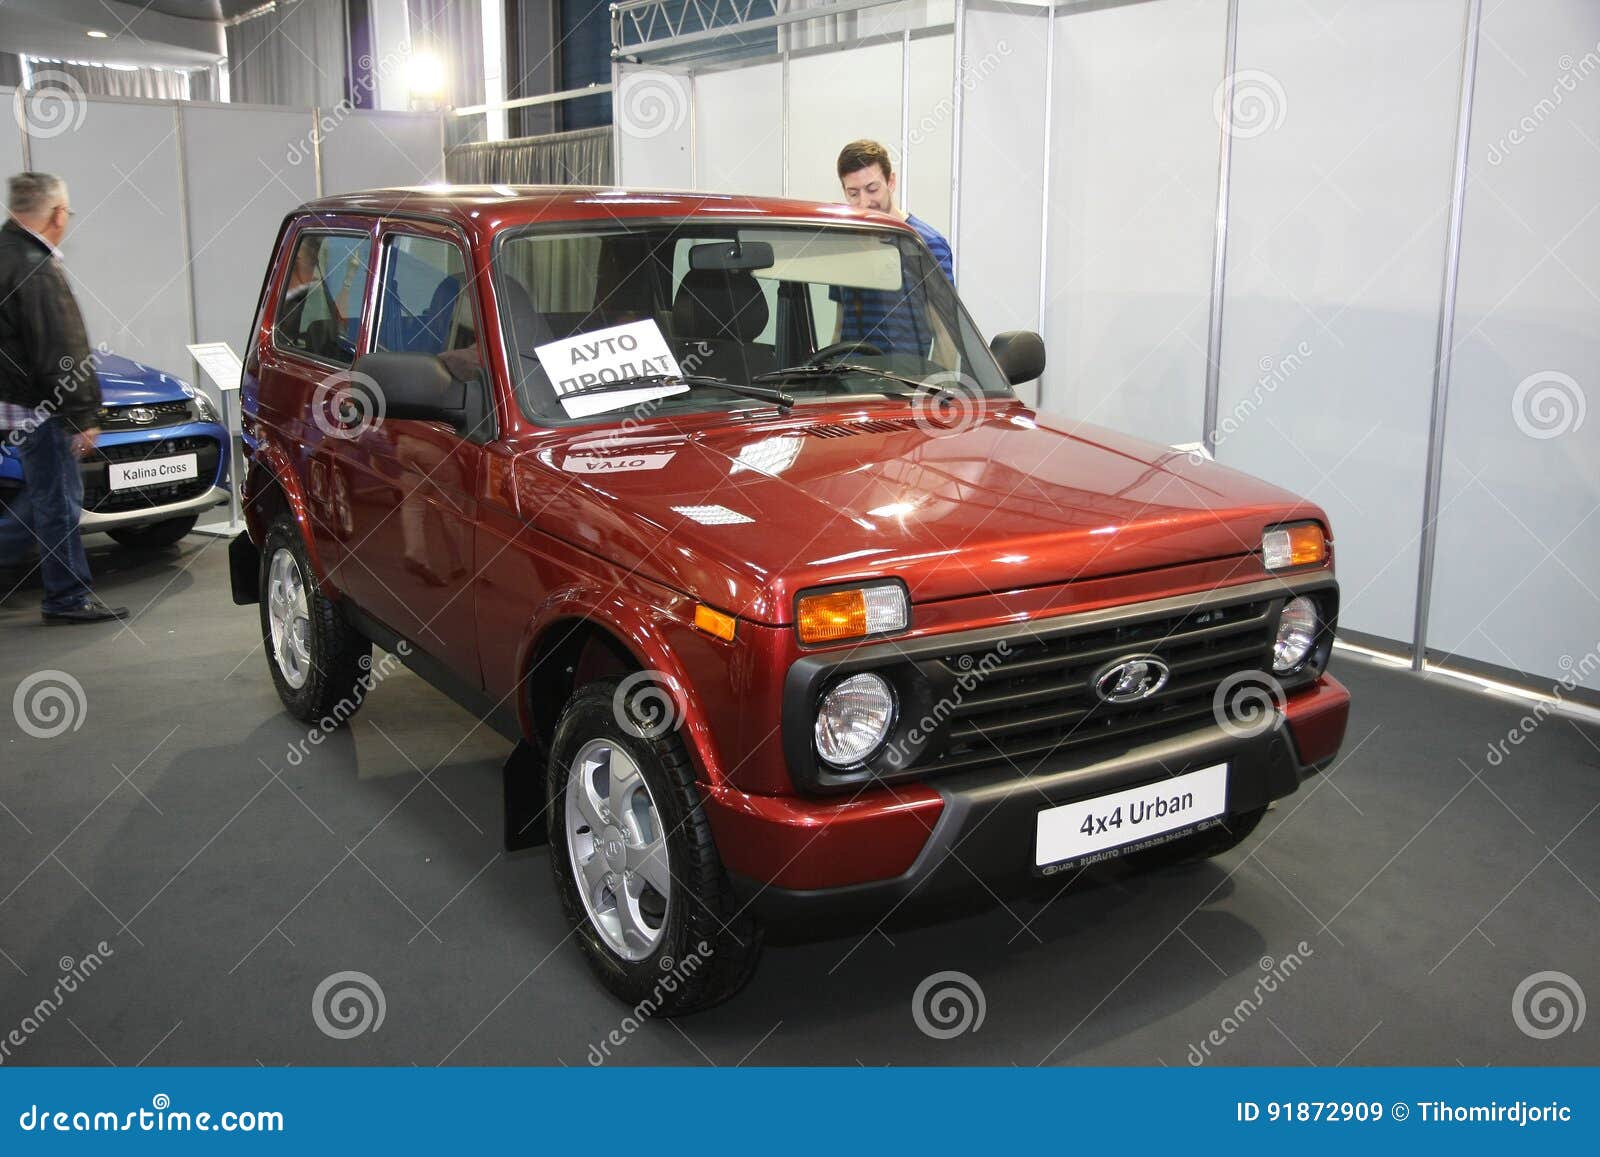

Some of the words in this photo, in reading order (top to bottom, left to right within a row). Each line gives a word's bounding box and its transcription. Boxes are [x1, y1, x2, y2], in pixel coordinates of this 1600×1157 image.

[571, 334, 638, 366] АУТО
[123, 466, 157, 480] Kalina
[159, 462, 187, 476] Cross
[1079, 806, 1122, 836] 4x4
[1129, 792, 1193, 825] Urban
